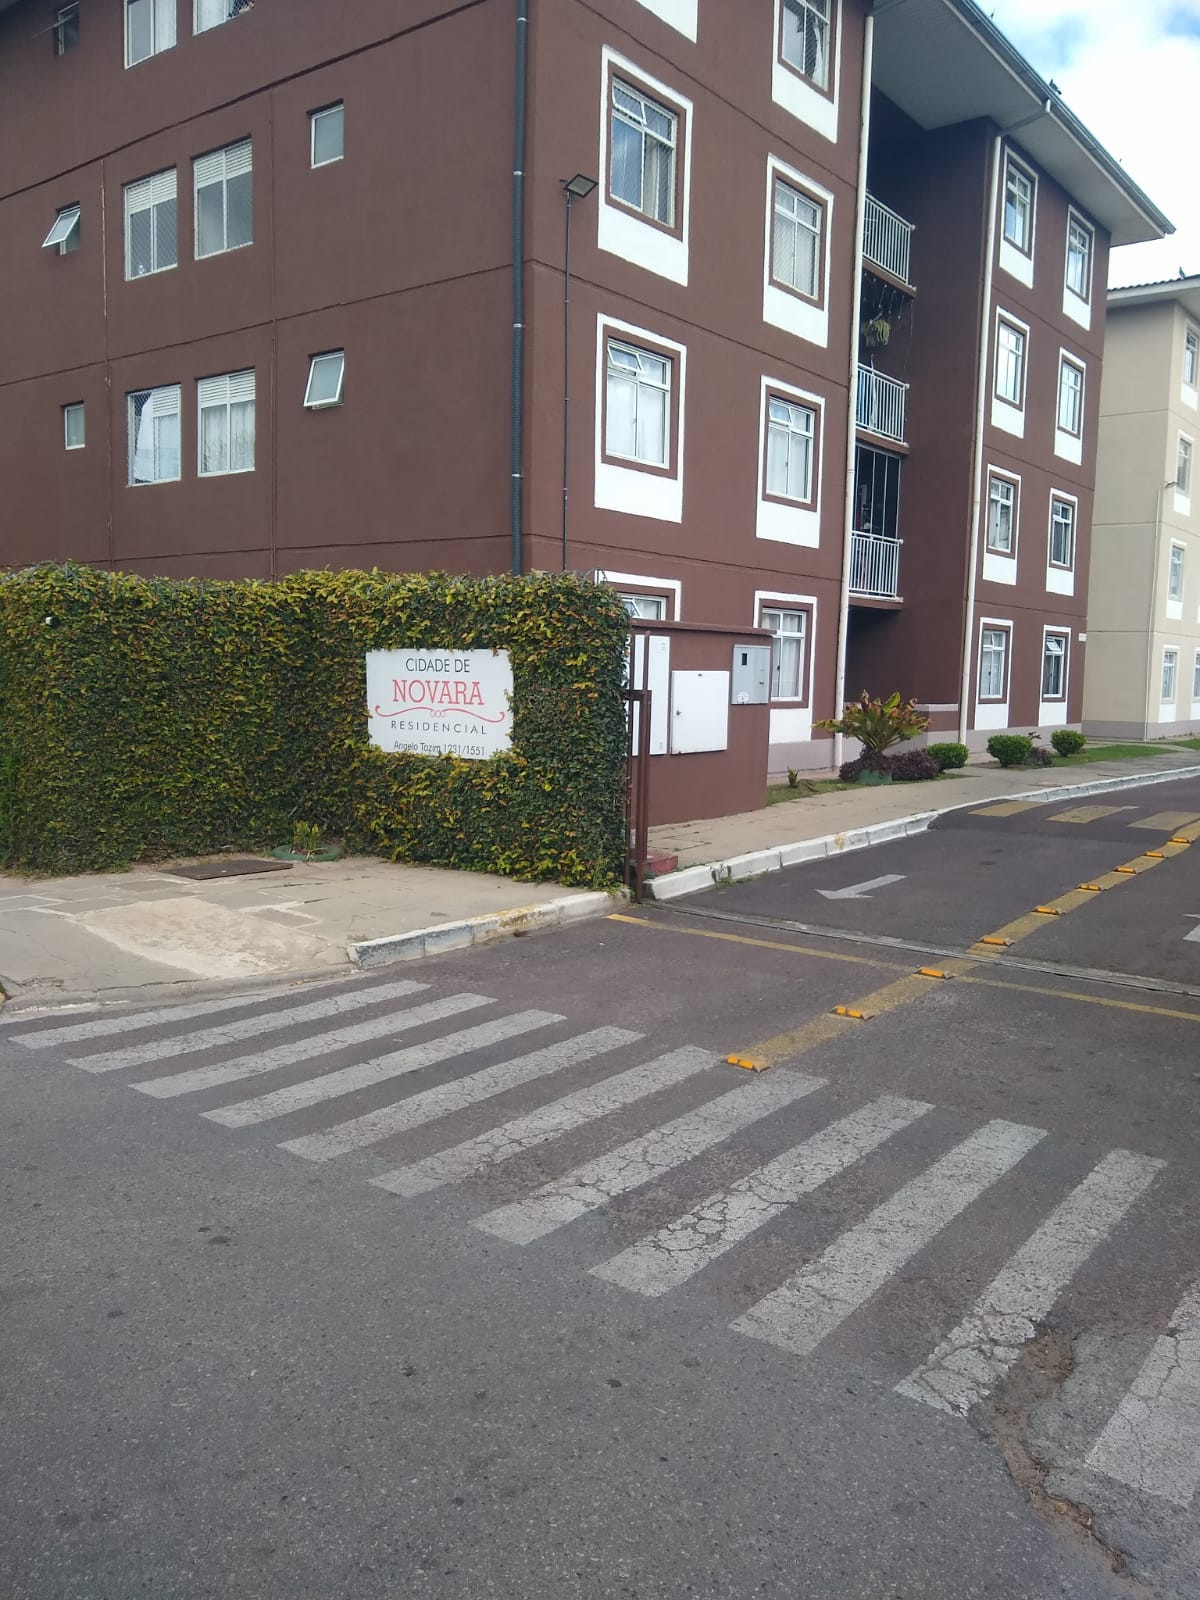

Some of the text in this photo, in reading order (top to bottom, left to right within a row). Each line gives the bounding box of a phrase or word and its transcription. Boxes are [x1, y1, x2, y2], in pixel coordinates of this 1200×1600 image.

[405, 658, 470, 673] CIDADE DE
[392, 679, 485, 706] NOVARA
[391, 720, 487, 735] RESIDENCIAL
[443, 743, 485, 756] 1231/1551
